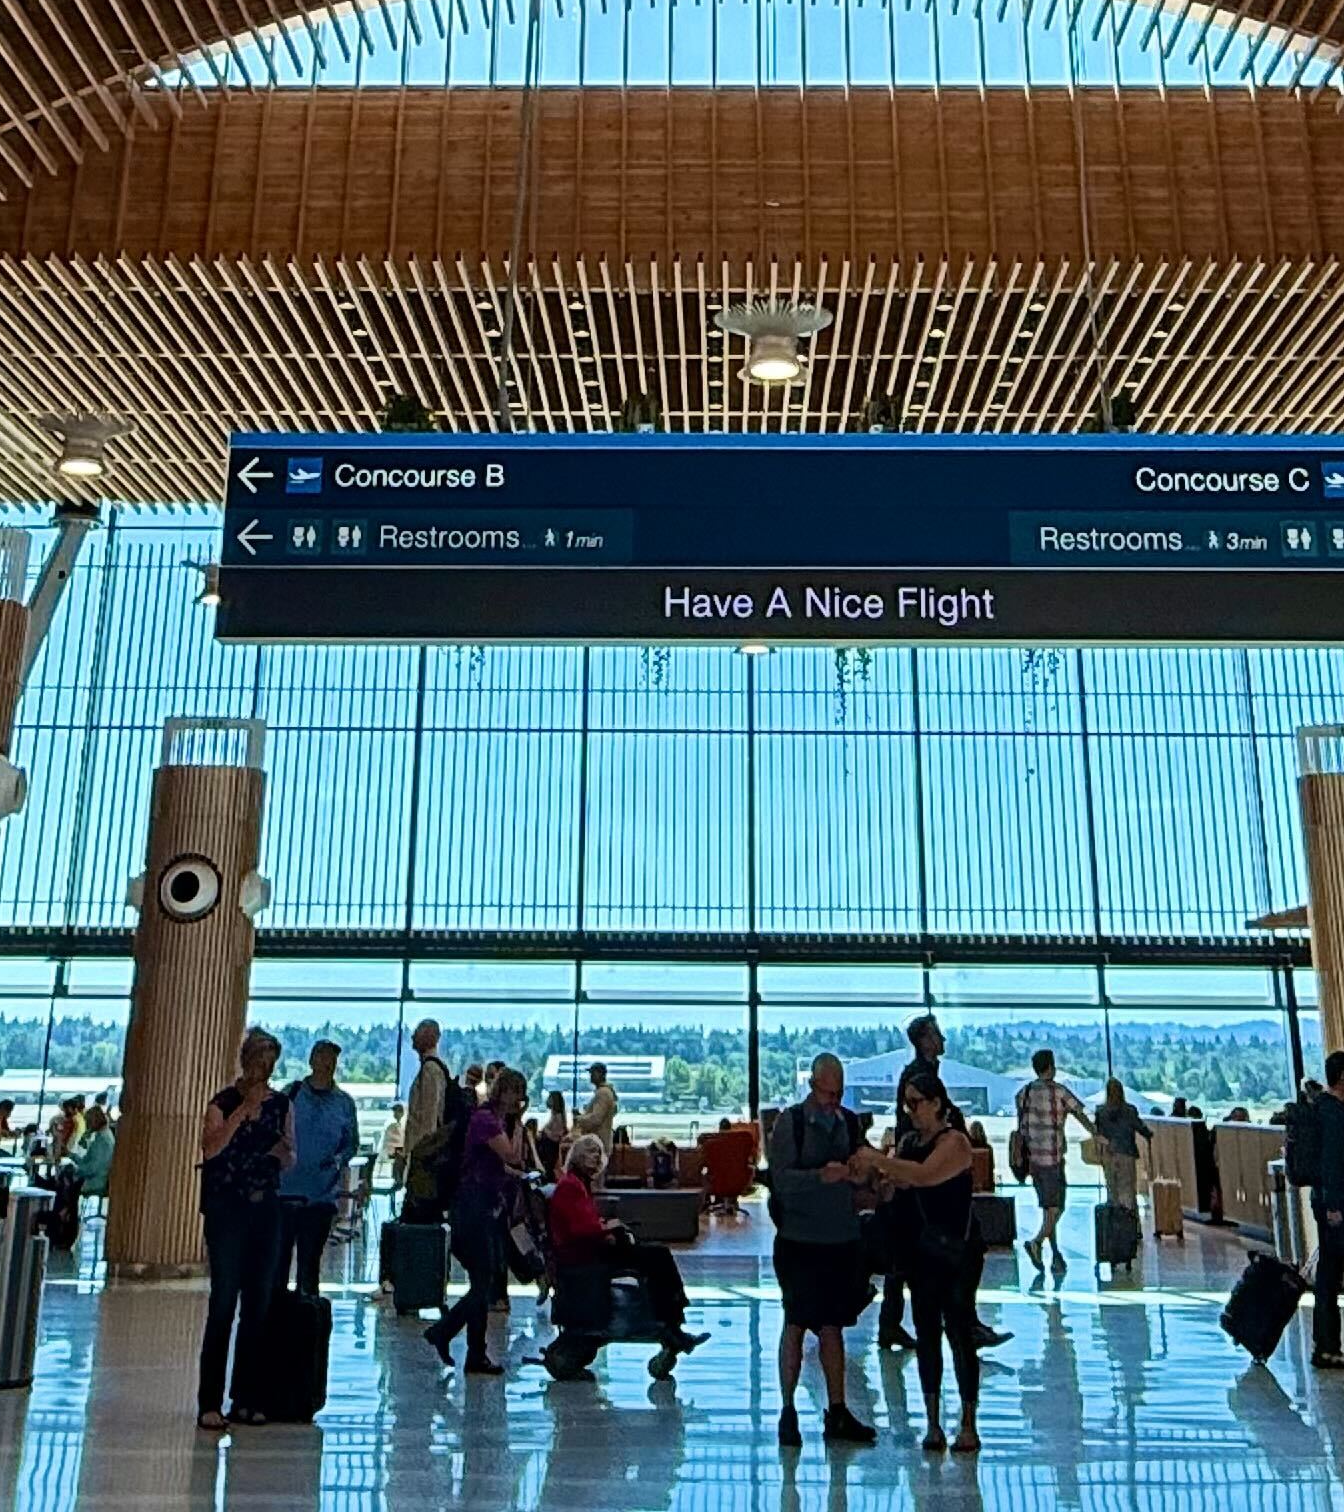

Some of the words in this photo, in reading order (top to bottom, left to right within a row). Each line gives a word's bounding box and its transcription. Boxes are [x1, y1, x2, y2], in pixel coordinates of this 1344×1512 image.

[334, 463, 477, 489] Concourse
[485, 463, 506, 488] B
[1135, 466, 1281, 493] Concourse
[1288, 467, 1311, 493] C
[379, 524, 521, 549] Restrooms
[1040, 525, 1184, 552] Restrooms
[664, 586, 754, 619] Have
[766, 587, 792, 619] A
[805, 585, 885, 619] Nice
[898, 586, 995, 627] Flight
